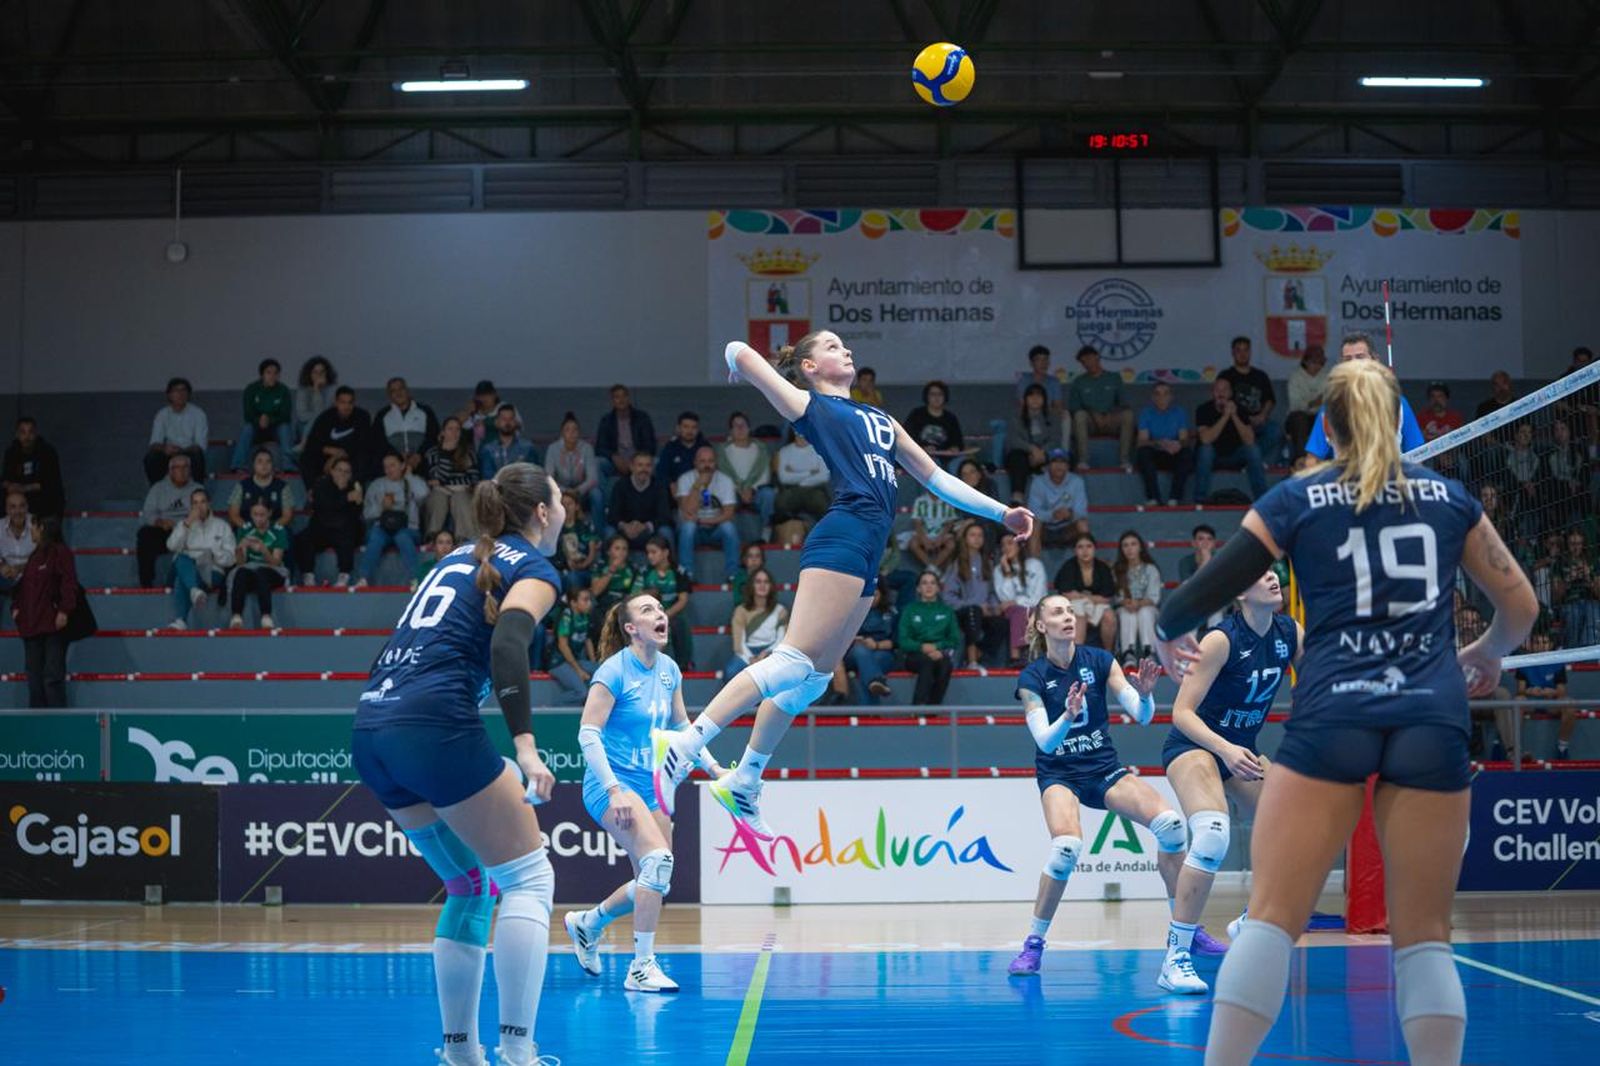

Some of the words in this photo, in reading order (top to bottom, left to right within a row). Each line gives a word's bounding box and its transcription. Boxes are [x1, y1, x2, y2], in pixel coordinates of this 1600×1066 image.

[1089, 134, 1149, 148] 19:10:57
[828, 276, 964, 300] Ayuntamiento
[968, 275, 993, 295] de
[1341, 274, 1472, 296] Ayuntamiento
[1477, 275, 1501, 294] de
[829, 304, 873, 323] Dos
[880, 303, 995, 322] Hermanas
[1065, 306, 1091, 319] Dos
[1096, 305, 1163, 319] Hermanas
[1342, 301, 1386, 320] Dos
[1392, 301, 1503, 321] Hermanas
[855, 409, 896, 451] 18
[1306, 478, 1450, 509] BRESTER
[1336, 523, 1440, 618] 19
[397, 563, 475, 629] 16
[1244, 667, 1281, 703] 12
[1493, 798, 1553, 825] CEV
[16, 813, 181, 868] Cajasol
[713, 804, 1016, 877] Andalucía
[1493, 833, 1600, 862] Challen
[1095, 861, 1112, 872] de
